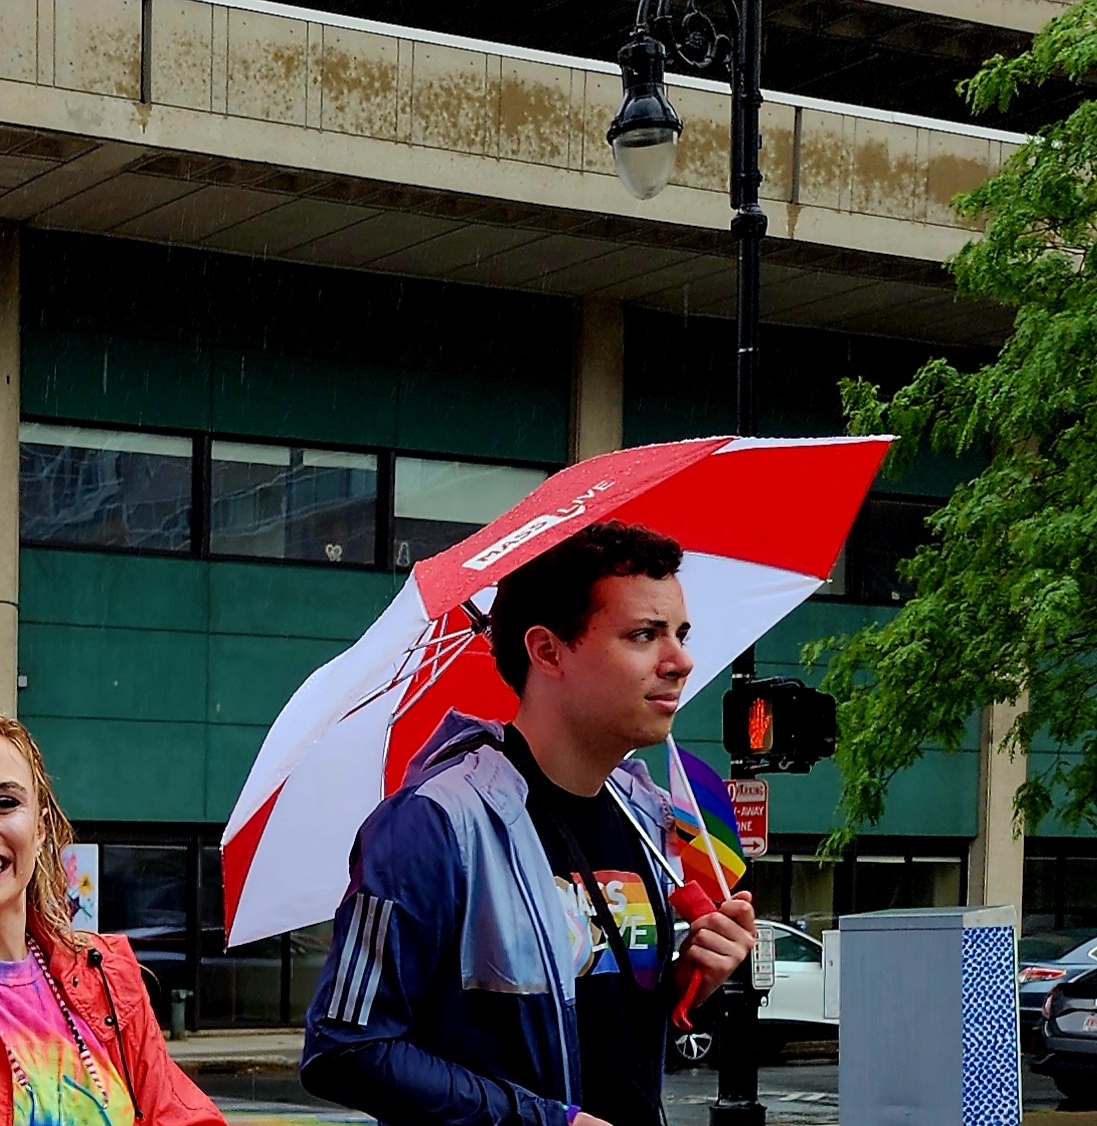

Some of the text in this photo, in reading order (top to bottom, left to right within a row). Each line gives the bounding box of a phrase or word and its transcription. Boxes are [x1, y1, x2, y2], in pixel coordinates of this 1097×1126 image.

[476, 480, 615, 562] MASS LIVE
[733, 806, 765, 817] -AWAY
[736, 821, 753, 832] ONE
